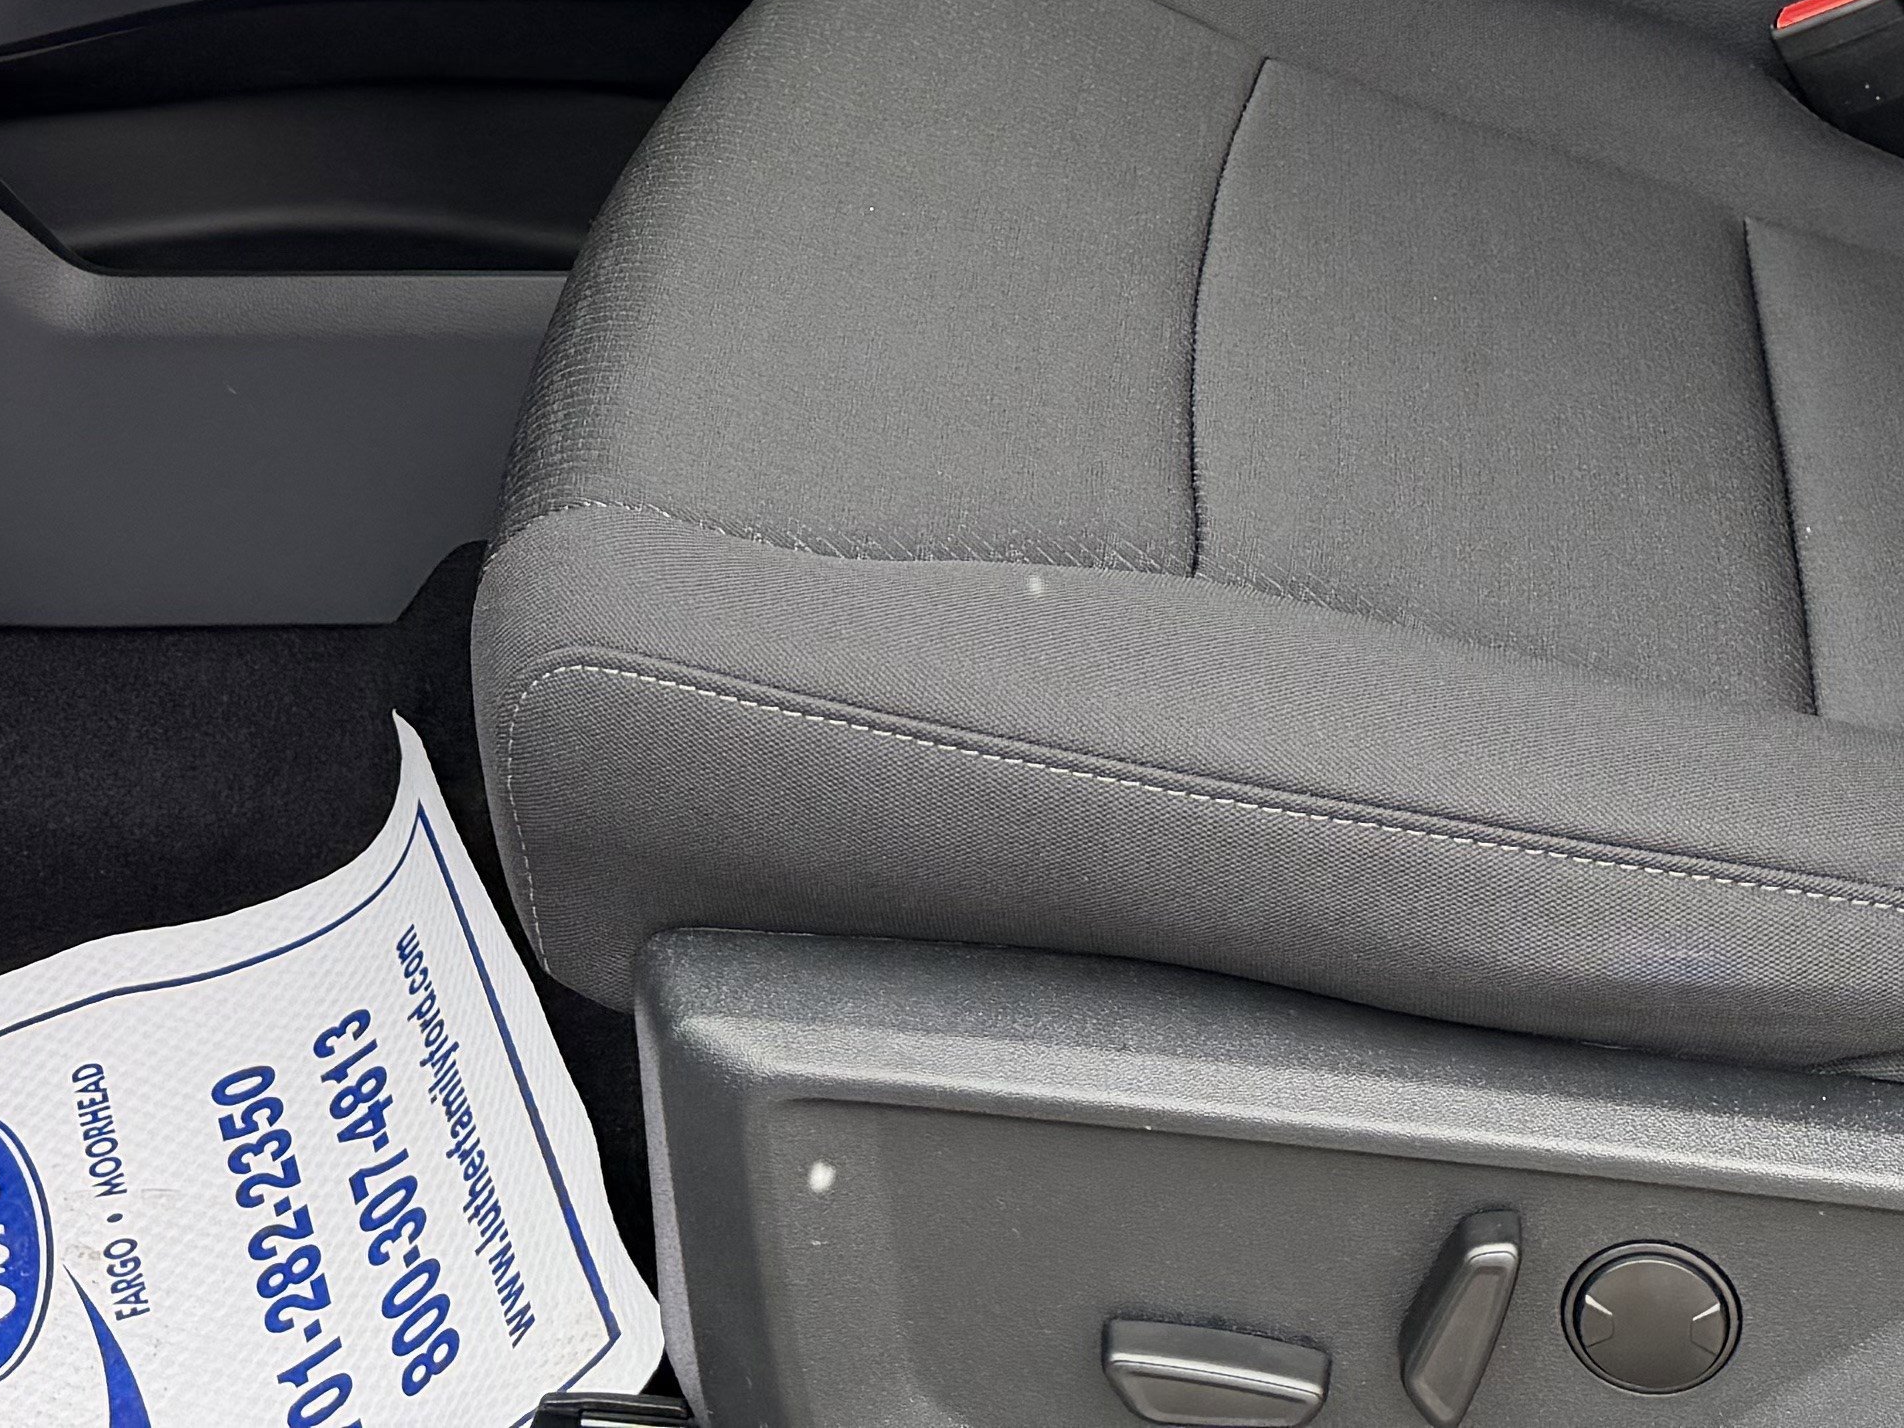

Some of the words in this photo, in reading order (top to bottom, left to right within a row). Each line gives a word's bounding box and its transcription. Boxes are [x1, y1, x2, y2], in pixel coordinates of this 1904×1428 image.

[71, 1063, 128, 1198] MOORHEAD
[103, 1238, 150, 1320] FARGO
[210, 1066, 363, 1428] 01-282-2350
[313, 1008, 460, 1397] 800-307-4813
[396, 924, 536, 1348] www.lutherfamilyford.com
